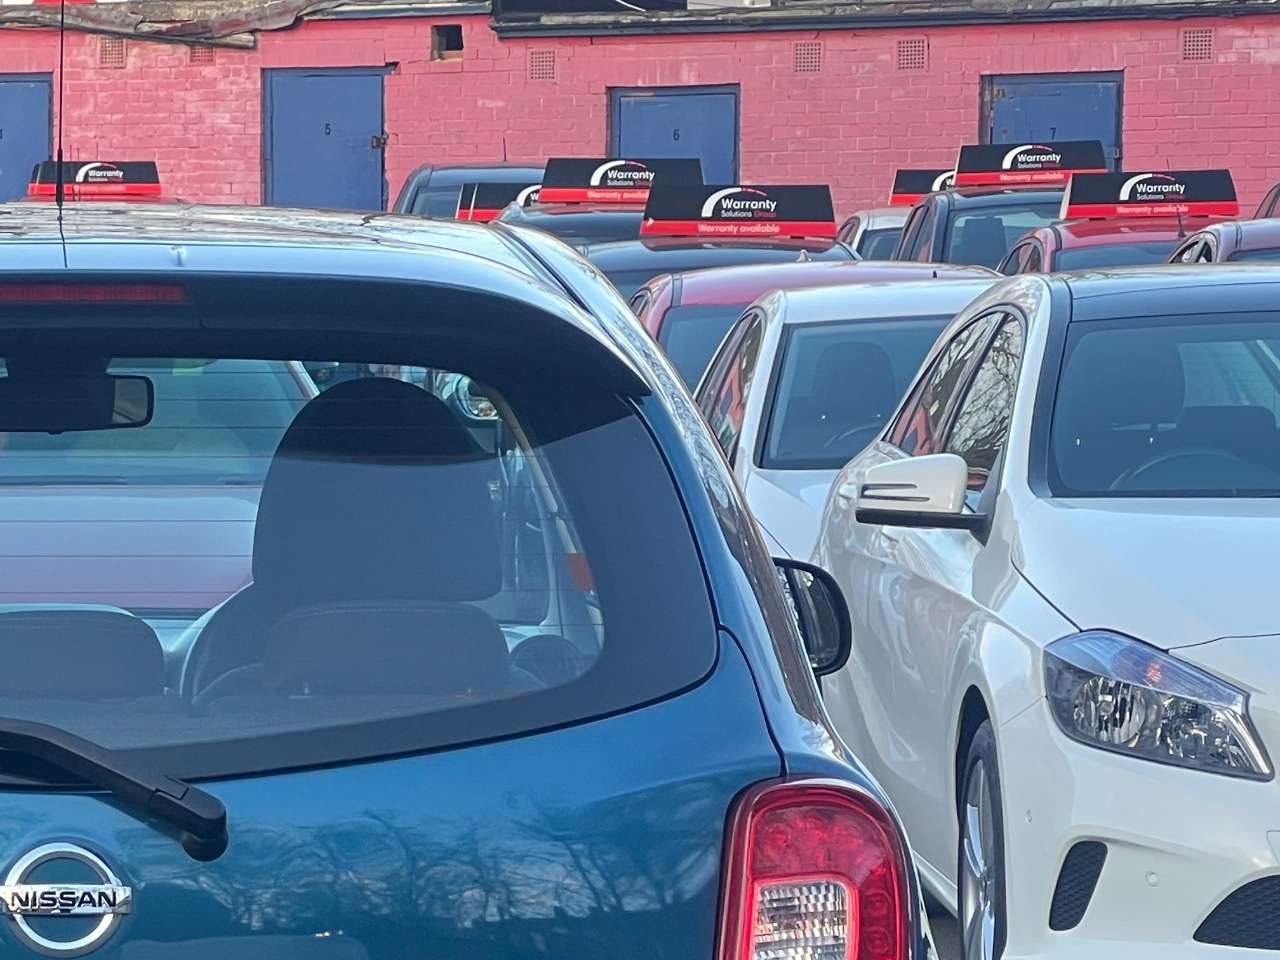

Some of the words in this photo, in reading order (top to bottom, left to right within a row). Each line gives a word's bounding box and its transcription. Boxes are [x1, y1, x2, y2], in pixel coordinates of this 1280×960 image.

[324, 123, 332, 136] 5
[673, 128, 680, 141] 6
[1049, 127, 1057, 141] 7
[1017, 153, 1061, 163] Warranty
[87, 169, 124, 178] Warranty
[607, 170, 655, 181] Warranty
[1136, 184, 1185, 194] Warranty
[720, 198, 777, 211] Warranty
[720, 209, 753, 217] Solutions
[1116, 206, 1152, 215] Warranty
[697, 224, 738, 234] Warranty
[739, 223, 780, 233] available
[10, 891, 117, 909] NISSAN
